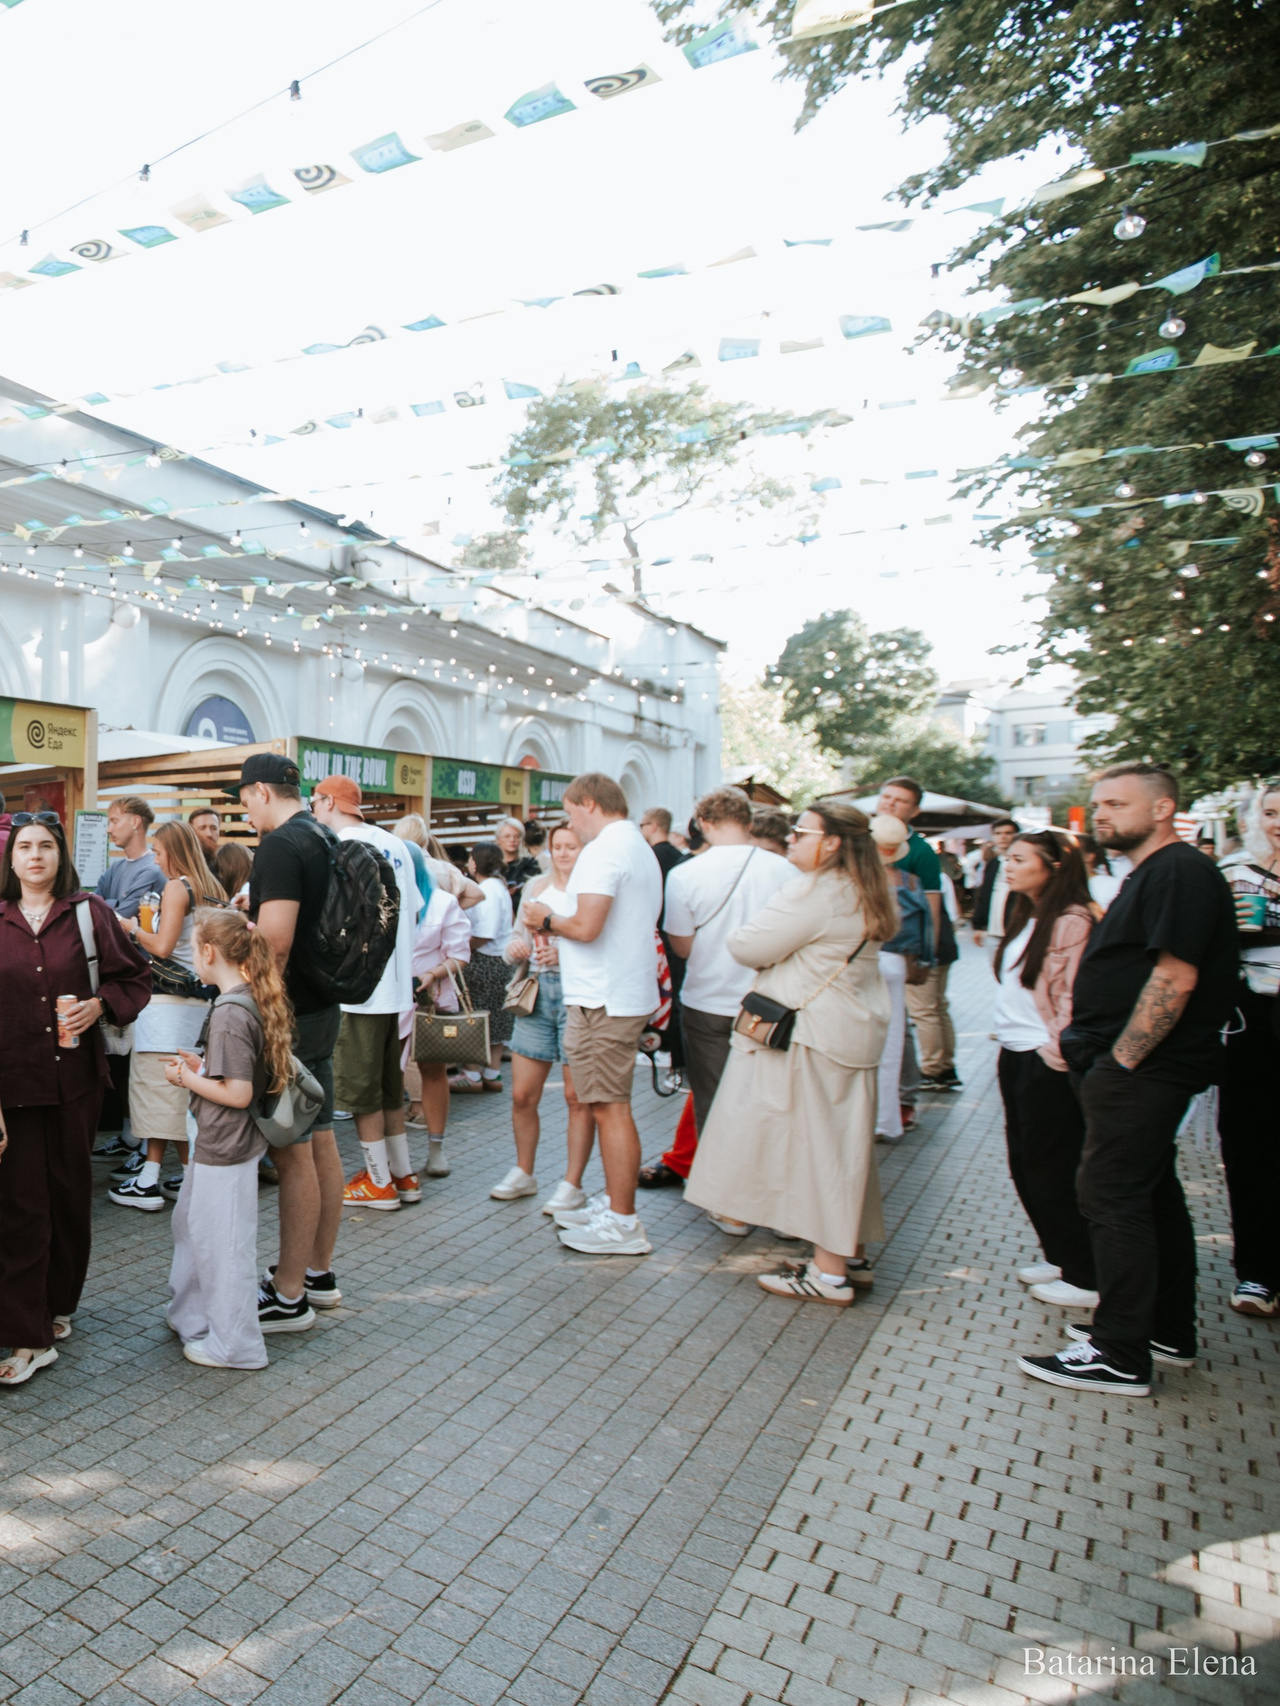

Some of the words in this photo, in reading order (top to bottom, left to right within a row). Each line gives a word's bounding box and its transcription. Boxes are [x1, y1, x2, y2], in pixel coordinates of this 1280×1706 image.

[47, 722, 78, 738] Яндекс
[47, 737, 64, 750] Еда
[303, 750, 329, 780] SOUL
[332, 753, 343, 777] IN
[345, 755, 362, 783] THE
[363, 757, 387, 787] BOWL
